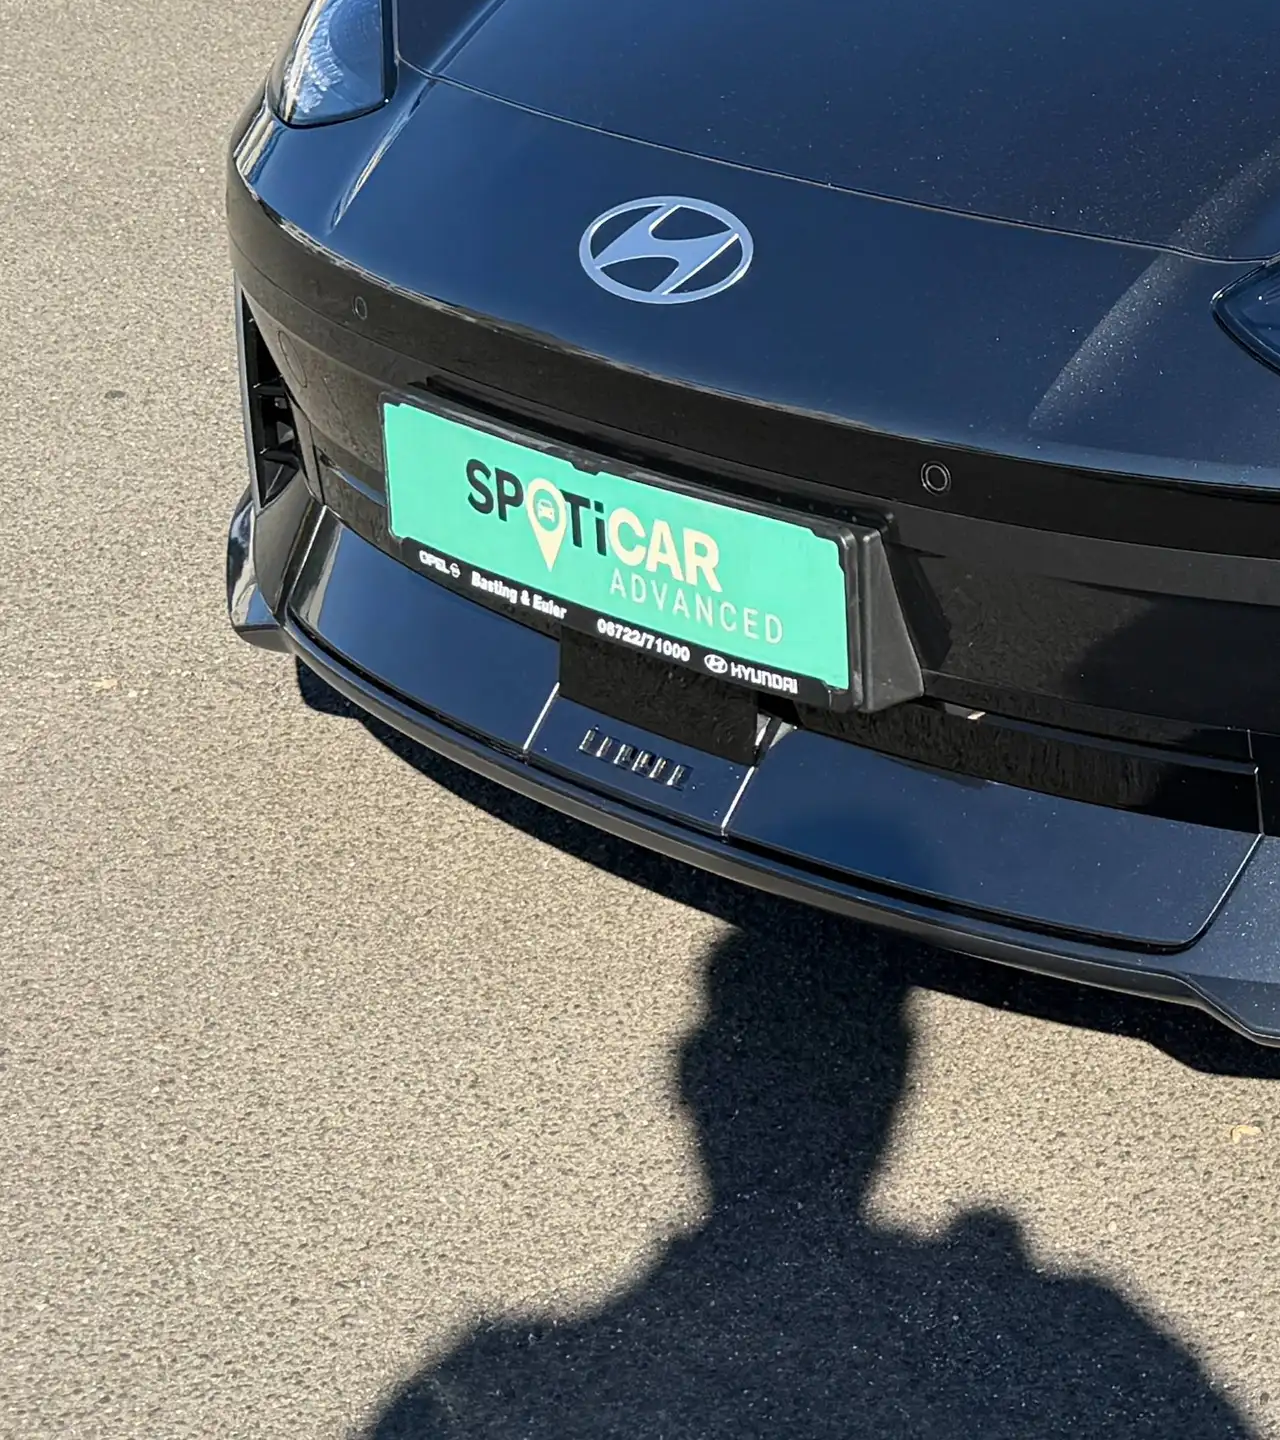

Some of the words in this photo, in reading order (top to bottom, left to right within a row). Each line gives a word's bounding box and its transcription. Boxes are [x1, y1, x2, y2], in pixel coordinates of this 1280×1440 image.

[418, 549, 451, 575] OPEL
[471, 570, 518, 604] Basting
[519, 589, 530, 606] &
[532, 593, 567, 620] Euler
[730, 661, 798, 694] HYUNDAI
[609, 568, 784, 645] ADVANCED
